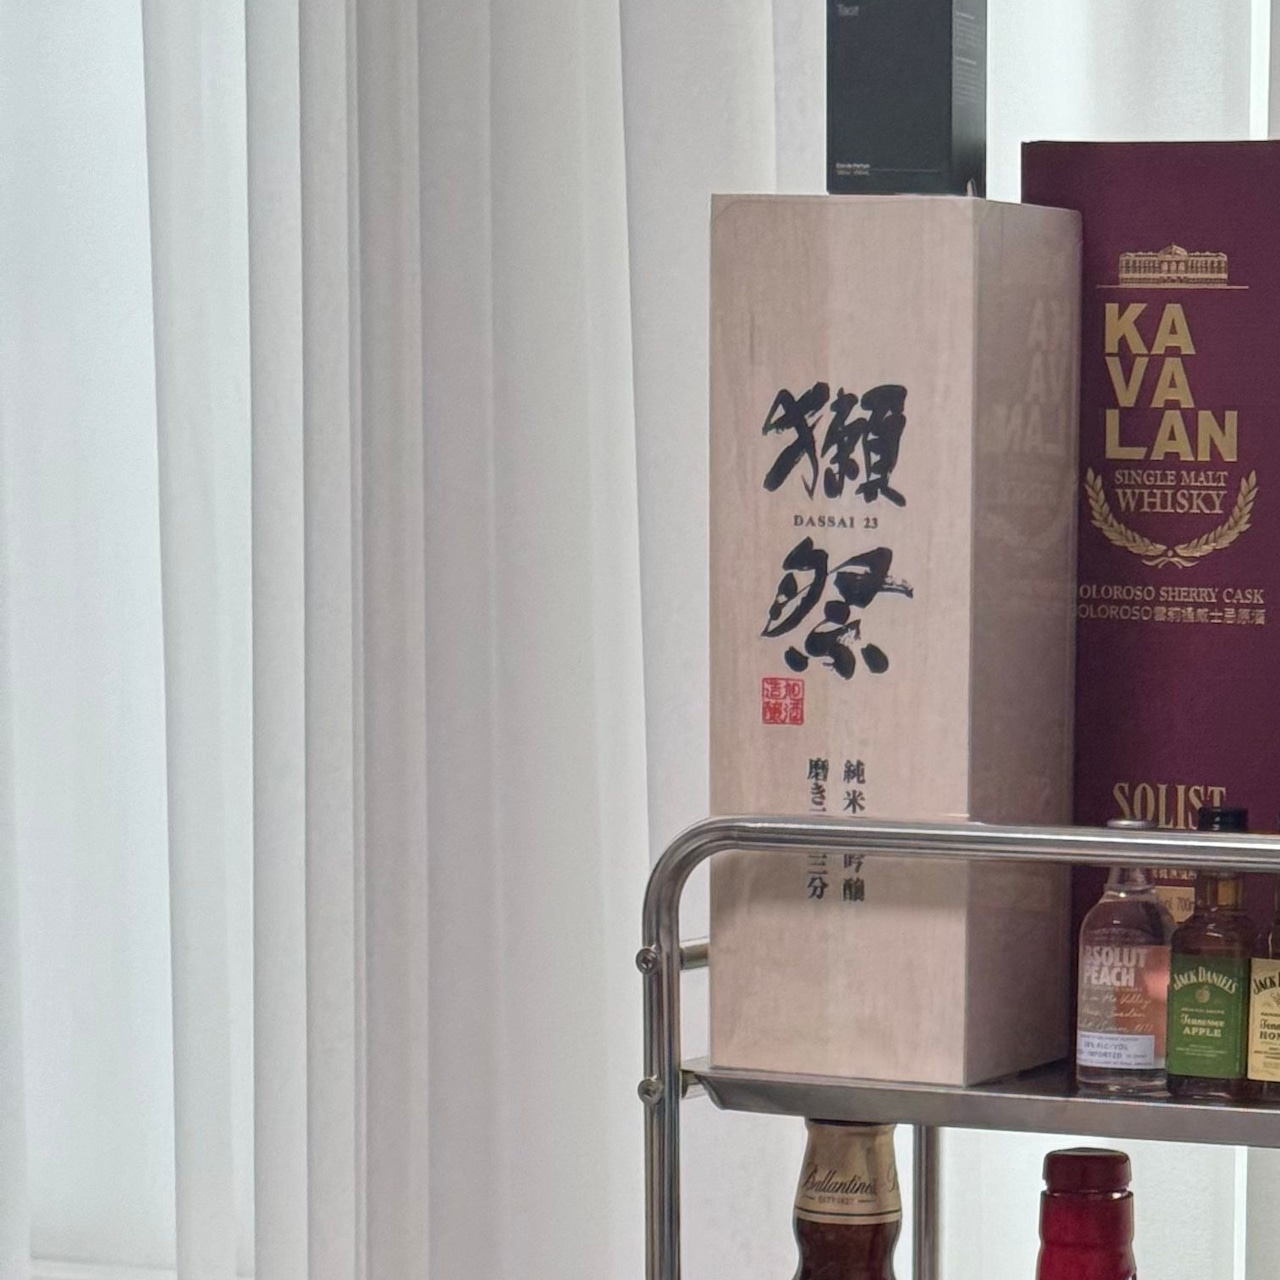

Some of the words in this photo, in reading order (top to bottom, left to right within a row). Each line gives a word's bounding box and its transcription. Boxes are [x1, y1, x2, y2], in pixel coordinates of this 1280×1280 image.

[1104, 302, 1196, 355] KA
[1104, 357, 1196, 408] VA
[1104, 410, 1238, 463] LAN
[1114, 469, 1178, 487] SINGLE
[1181, 470, 1229, 488] MALT
[1114, 488, 1225, 515] WHISKY
[793, 515, 856, 529] DASSAI
[863, 515, 880, 529] 23
[1079, 584, 1156, 602] OLOROSO
[1158, 586, 1219, 603] SHERRY
[1222, 588, 1266, 604] CASK
[843, 759, 866, 902] 純米吟醸
[1084, 946, 1147, 968] BSOLUT
[1083, 965, 1135, 987] PEACH
[1173, 971, 1197, 991] JACK
[1253, 976, 1276, 996] JACK
[1182, 1027, 1222, 1038] APPLE
